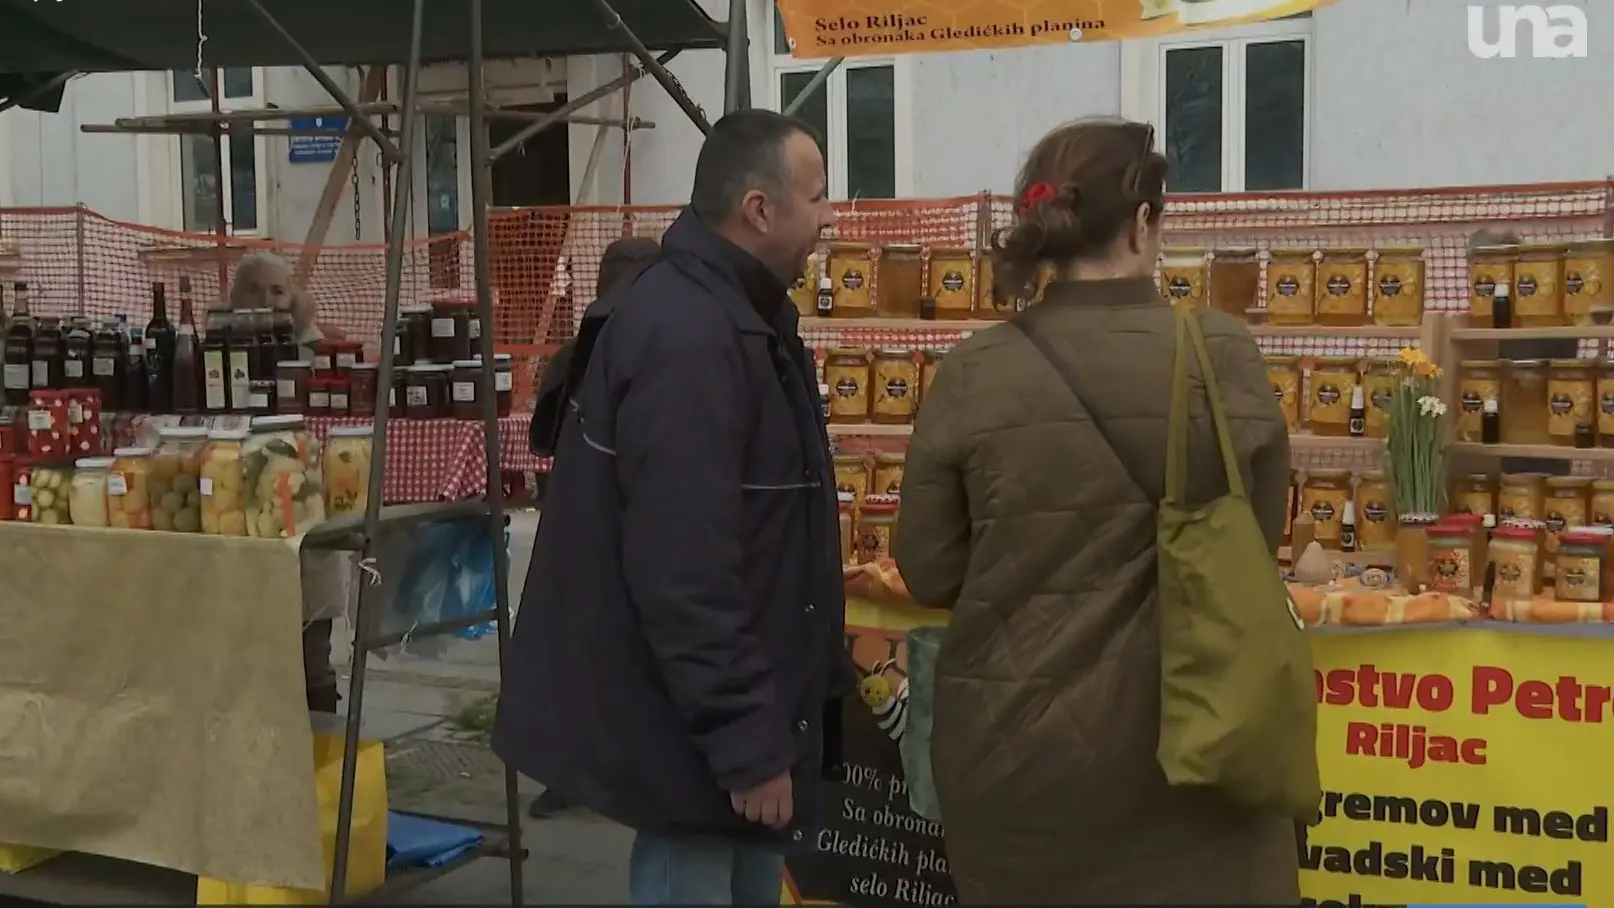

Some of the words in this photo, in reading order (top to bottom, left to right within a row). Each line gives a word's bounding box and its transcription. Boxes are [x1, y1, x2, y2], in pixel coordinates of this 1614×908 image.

[815, 17, 860, 31] Selo
[866, 14, 928, 31] Riljac
[816, 35, 837, 47] Sa
[841, 30, 926, 46] obronaka
[1031, 17, 1106, 37] planina
[1314, 664, 1454, 713] stvo
[1471, 664, 1614, 724] Petr
[1345, 721, 1488, 770] Riljac
[843, 798, 867, 823] Sa
[873, 804, 945, 838] obrona
[1317, 789, 1481, 831] remov
[1493, 805, 1608, 843] med
[916, 848, 951, 876] pla
[1297, 840, 1455, 885] vadski
[1467, 859, 1583, 897] med
[849, 872, 888, 898] selo
